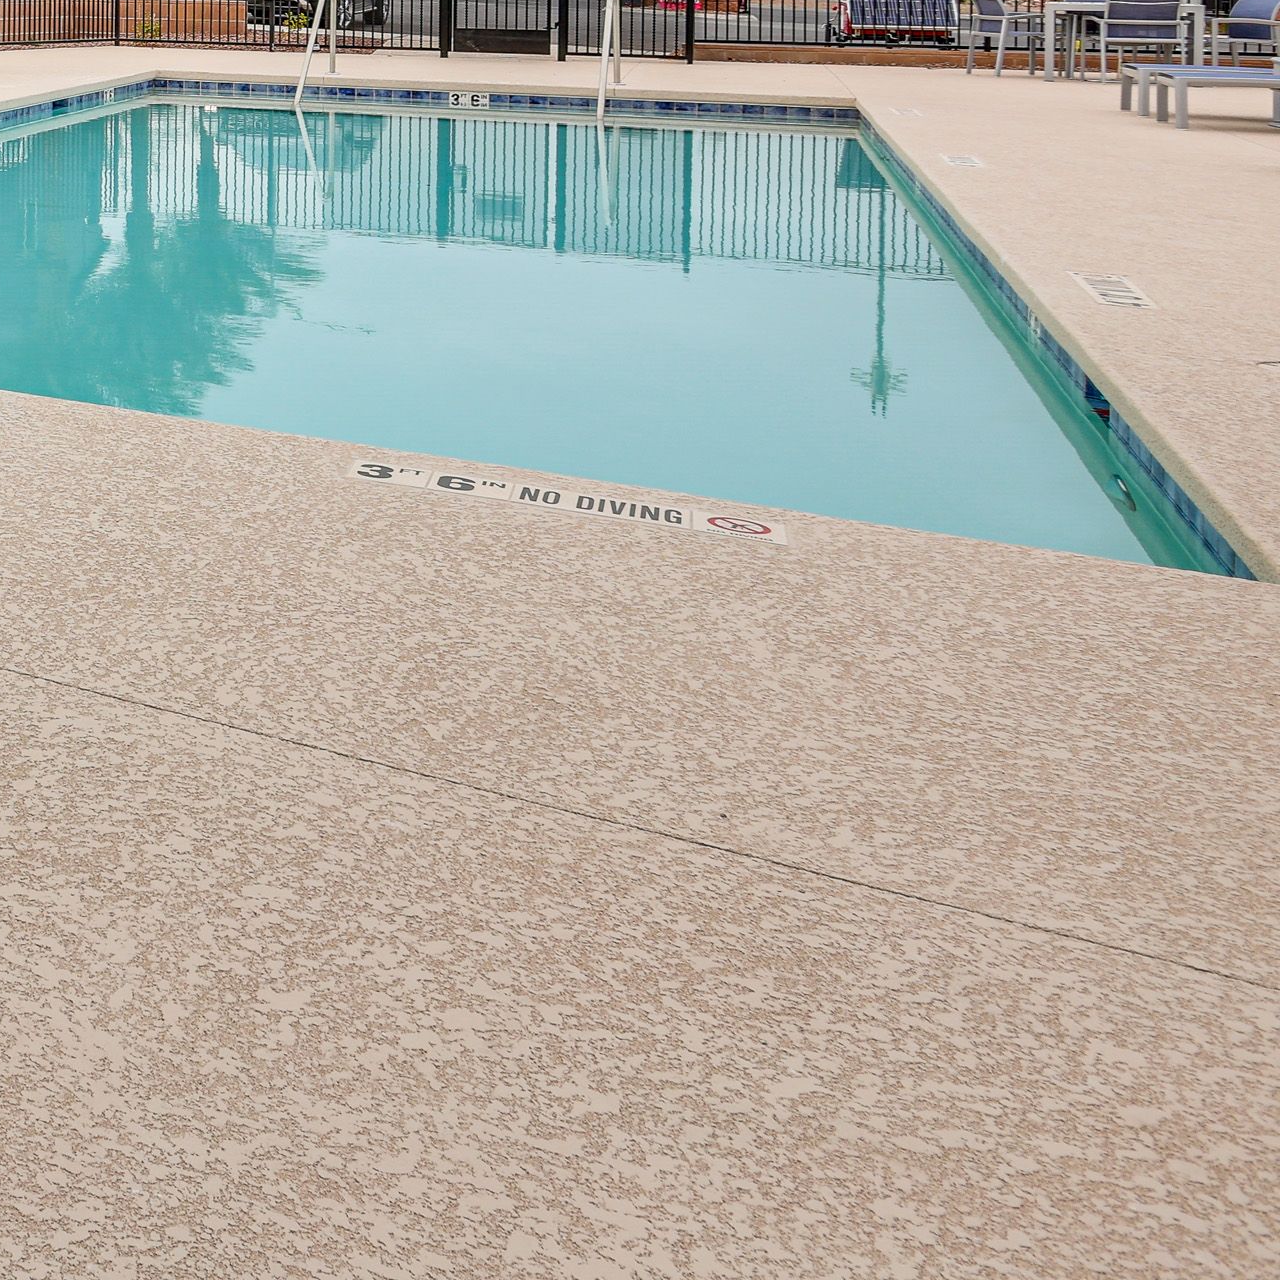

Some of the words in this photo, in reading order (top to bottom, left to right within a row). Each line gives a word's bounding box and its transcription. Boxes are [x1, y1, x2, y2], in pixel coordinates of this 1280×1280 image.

[356, 463, 394, 480] 3
[399, 468, 424, 476] FT
[437, 475, 475, 492] 6
[481, 480, 506, 489] IN
[519, 486, 561, 506] NO
[576, 495, 683, 525] DIVING
